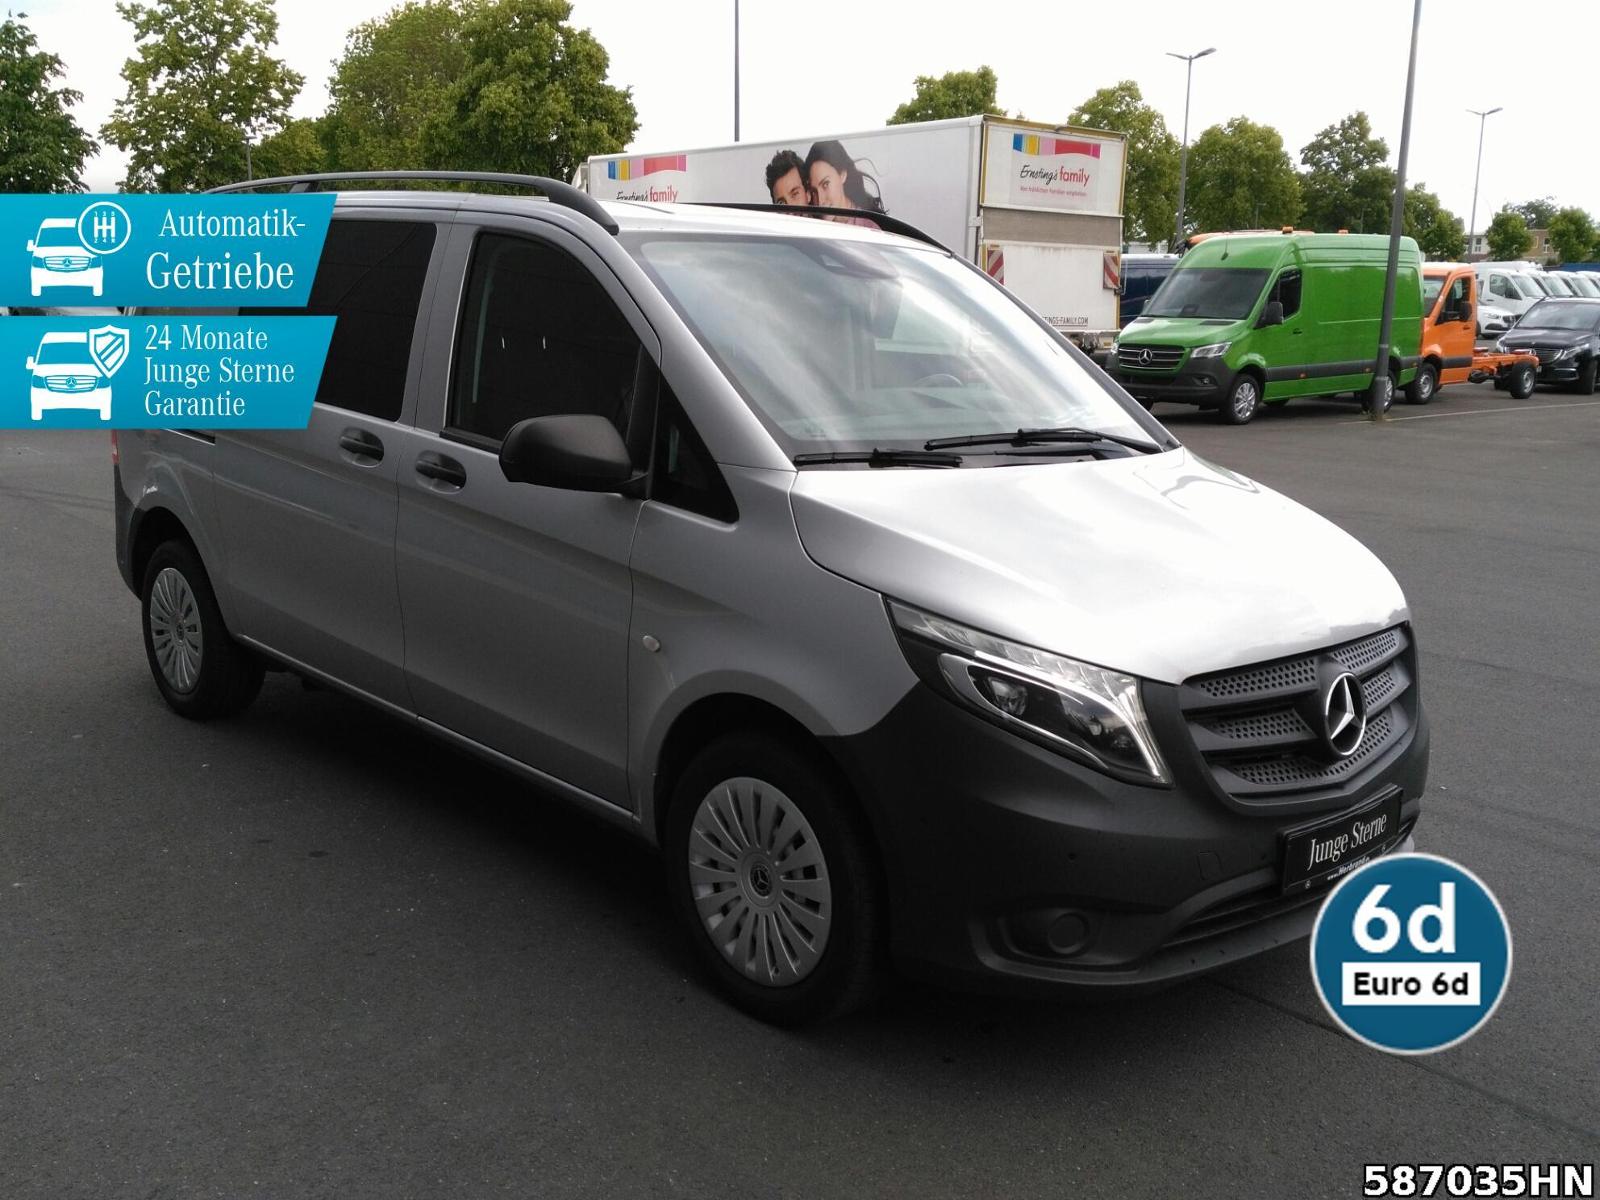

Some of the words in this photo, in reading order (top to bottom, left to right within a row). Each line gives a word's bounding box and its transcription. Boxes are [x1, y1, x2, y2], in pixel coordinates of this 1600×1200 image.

[1060, 165, 1090, 187] family
[649, 184, 679, 203] family
[1307, 833, 1349, 871] Junge
[1351, 813, 1387, 849] Sterne
